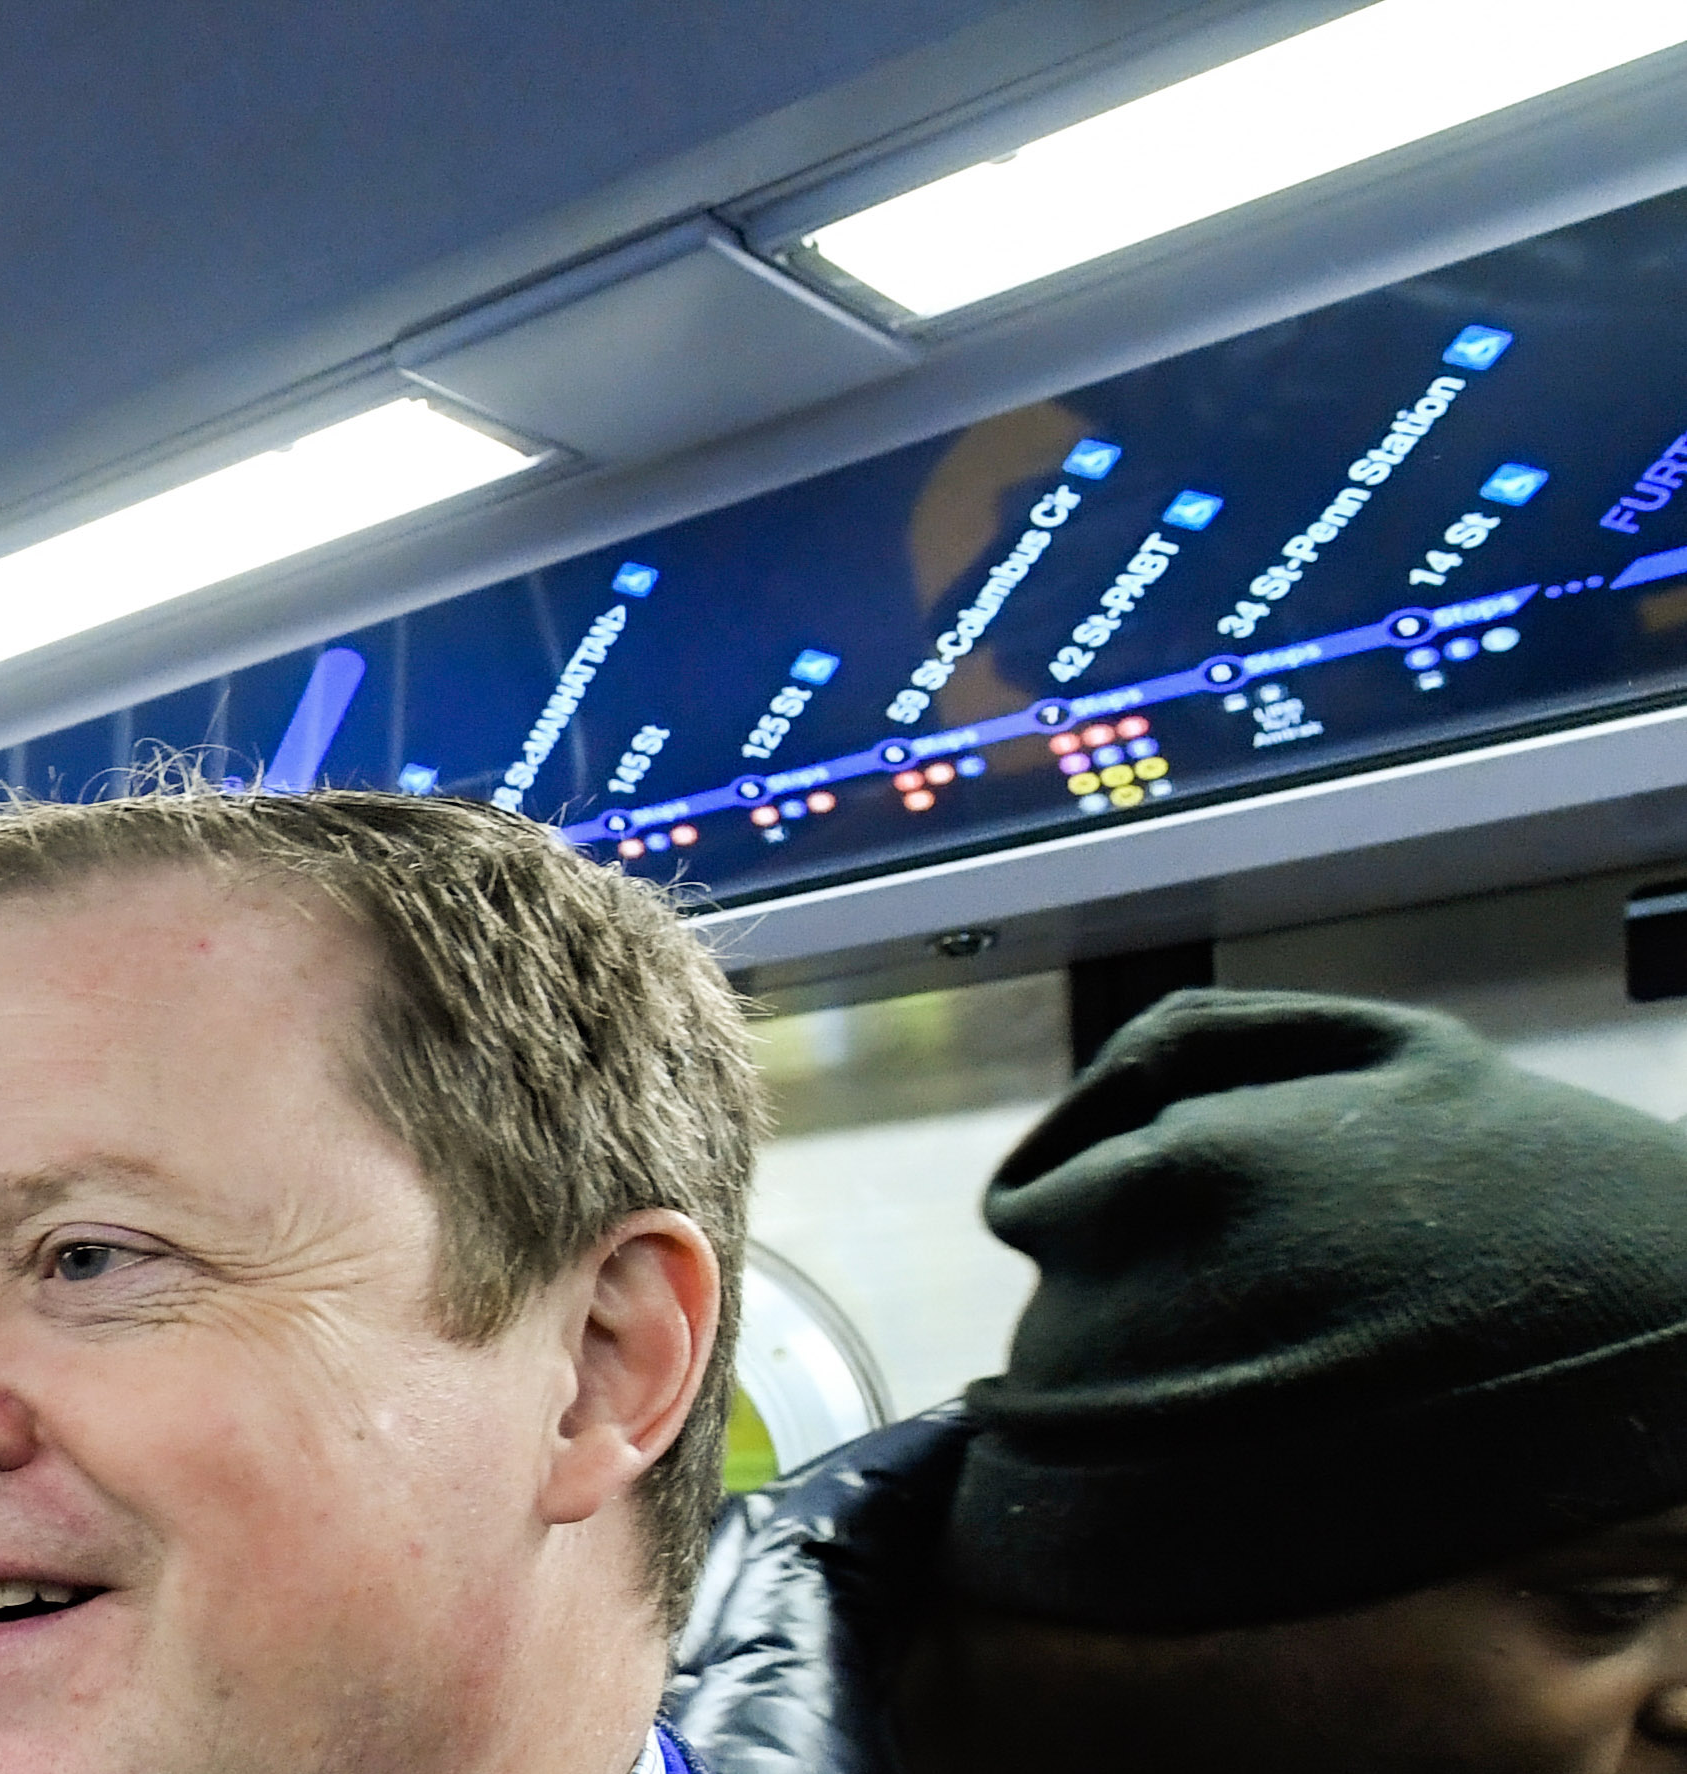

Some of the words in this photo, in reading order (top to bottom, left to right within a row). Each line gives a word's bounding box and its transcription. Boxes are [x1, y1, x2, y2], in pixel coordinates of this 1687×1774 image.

[1217, 600, 1271, 639] 34
[1249, 486, 1372, 600] St-Penn
[1347, 375, 1467, 486] Station
[1409, 549, 1463, 586] 14
[1444, 512, 1501, 549] St
[910, 529, 1052, 691] St-Columbus
[1029, 484, 1082, 528] Cir
[1048, 645, 1096, 683] 42
[1072, 531, 1180, 648] St-PABT
[607, 752, 652, 794] 145
[631, 724, 671, 756] St
[741, 714, 791, 759] 125
[769, 685, 814, 718] St
